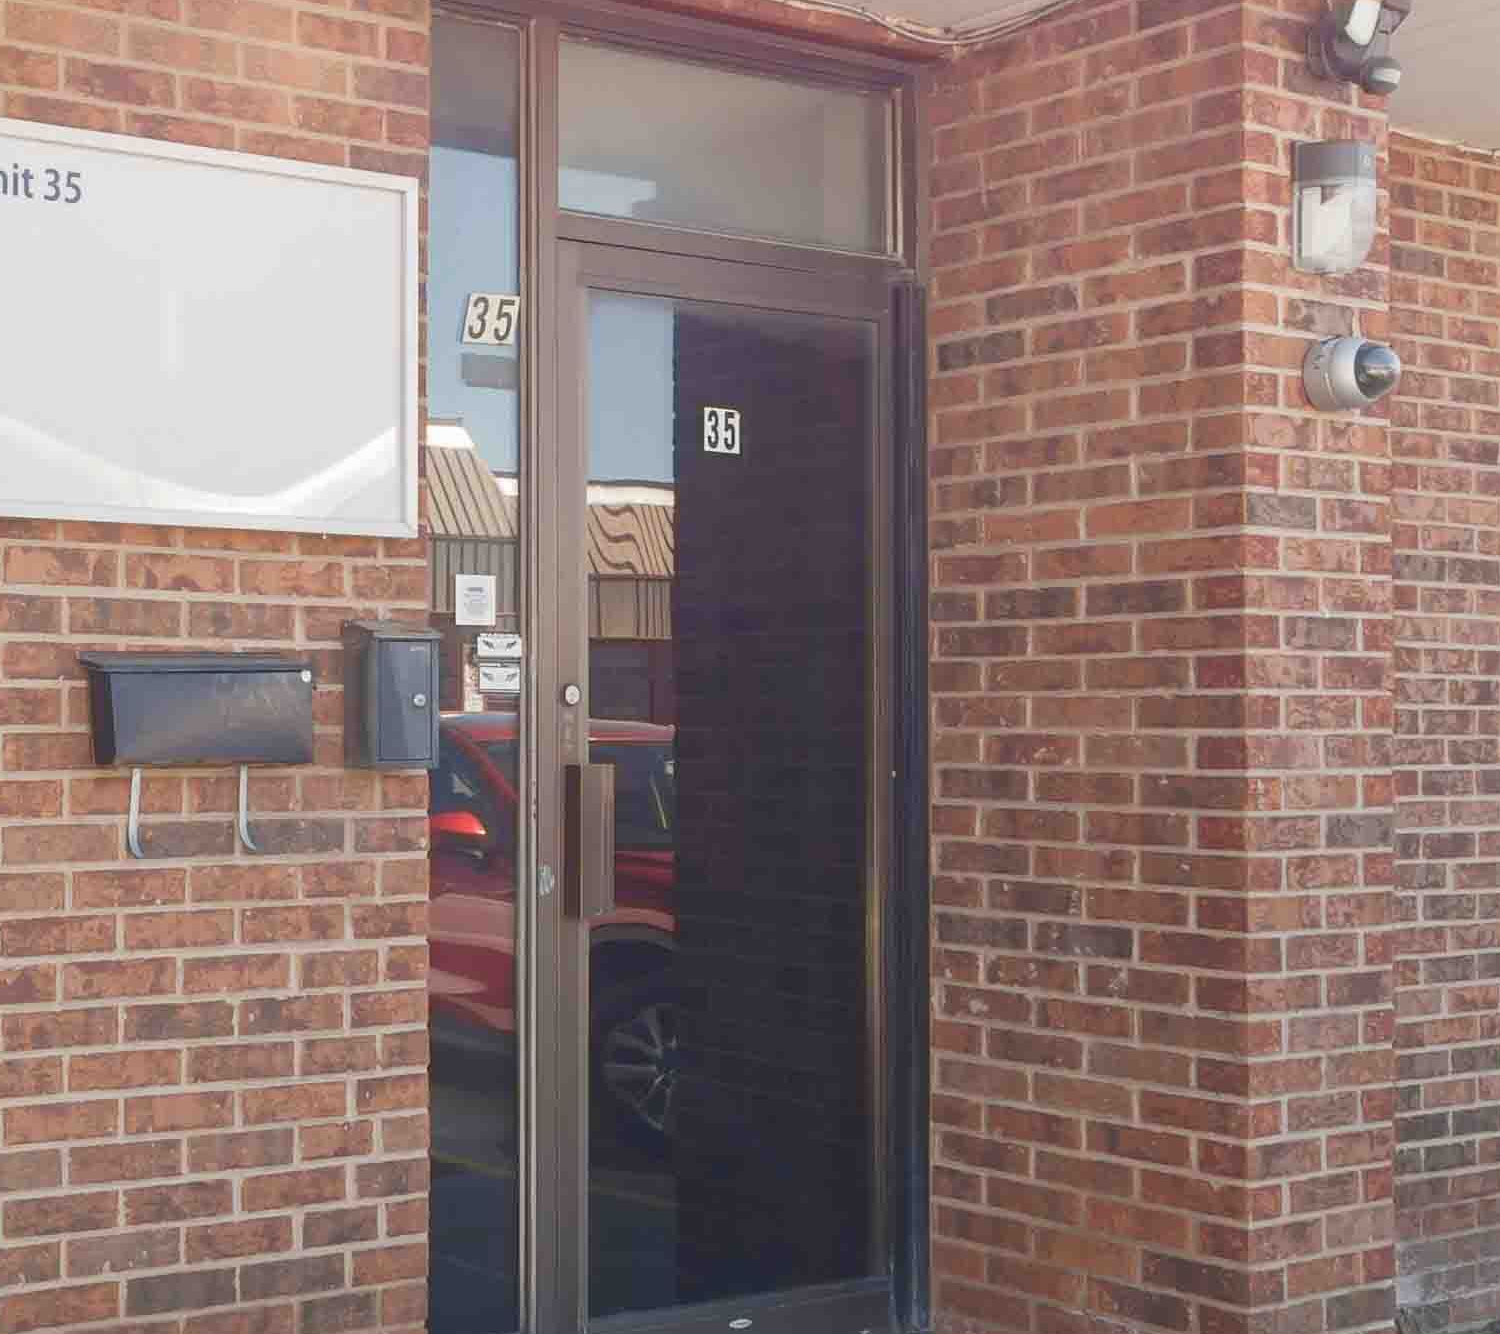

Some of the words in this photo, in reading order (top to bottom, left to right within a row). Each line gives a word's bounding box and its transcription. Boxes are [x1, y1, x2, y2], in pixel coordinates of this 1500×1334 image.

[43, 168, 82, 204] 35
[467, 296, 516, 341] 35
[707, 409, 736, 450] 35
